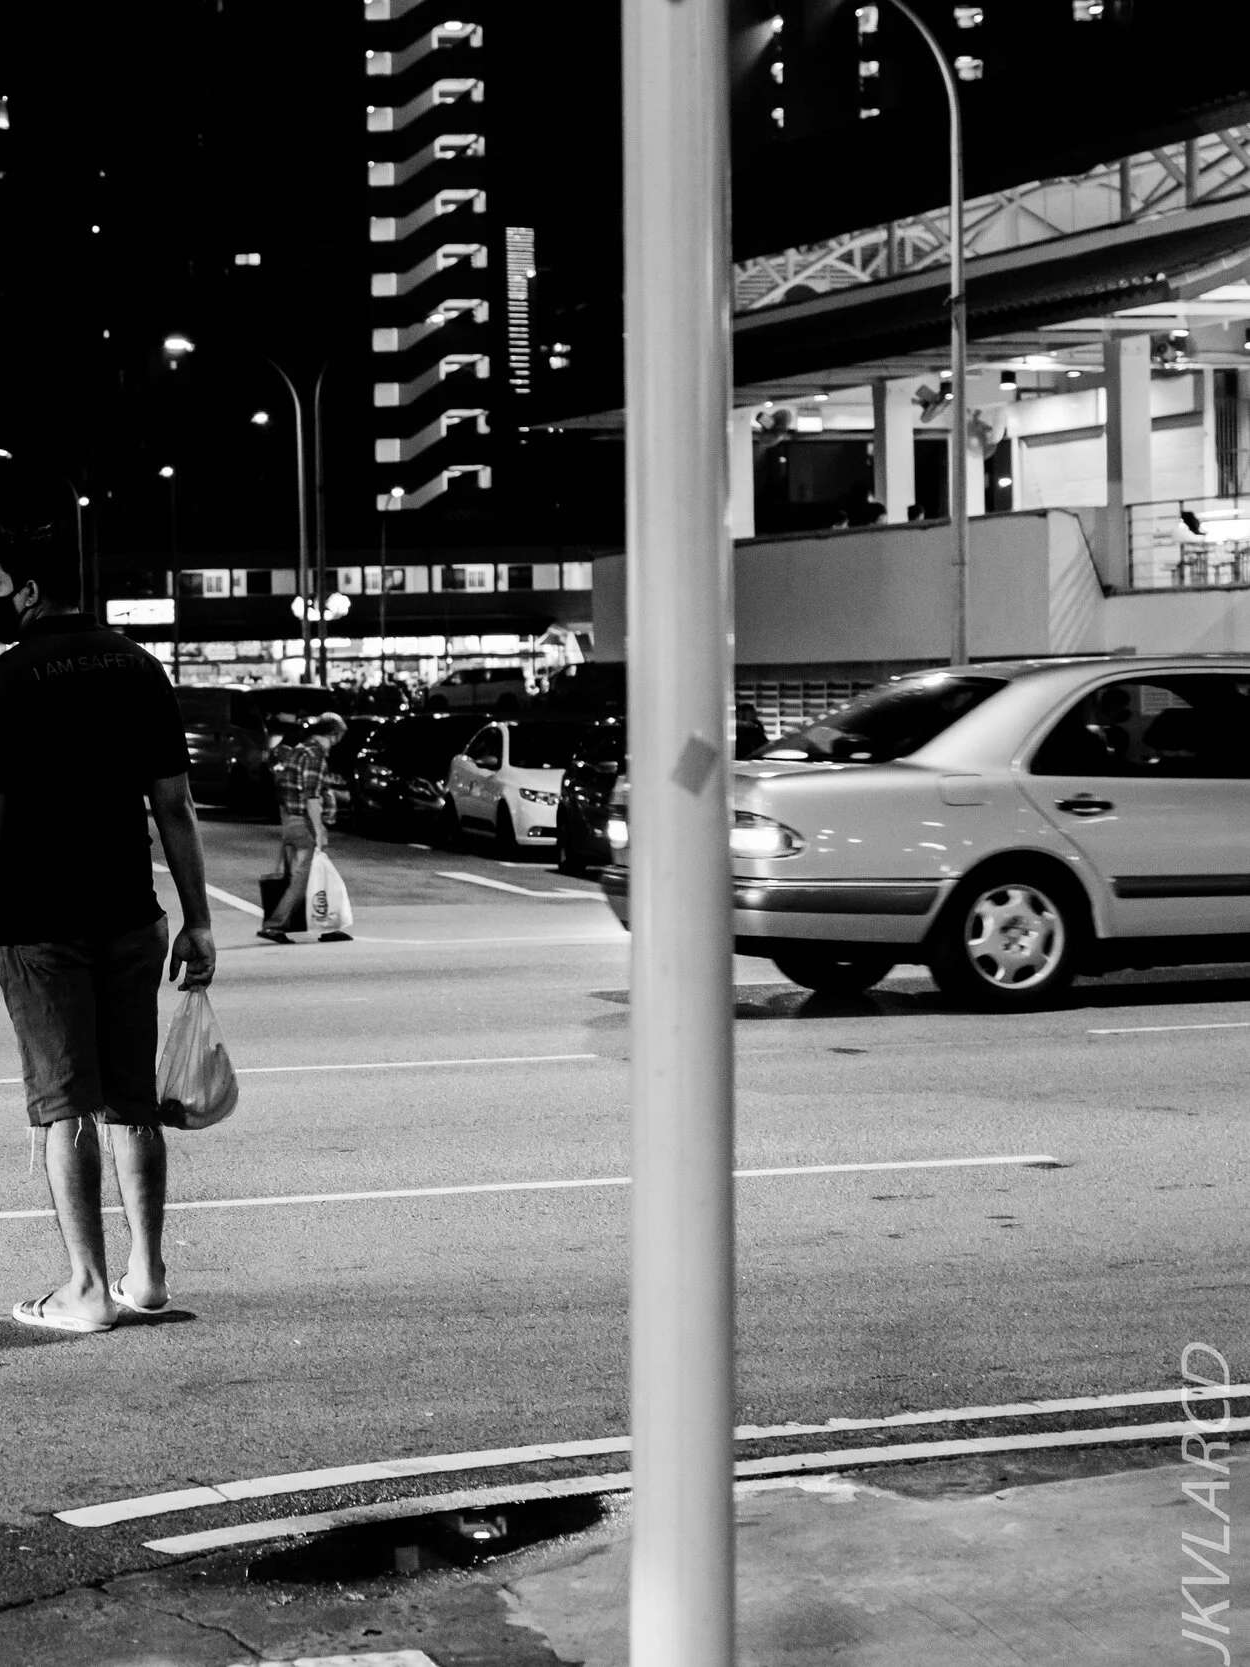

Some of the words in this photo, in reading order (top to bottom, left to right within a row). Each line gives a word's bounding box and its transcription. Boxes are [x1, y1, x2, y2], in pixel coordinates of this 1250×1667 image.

[33, 667, 41, 681] I
[46, 657, 75, 679] AM
[78, 652, 146, 671] SAFETY
